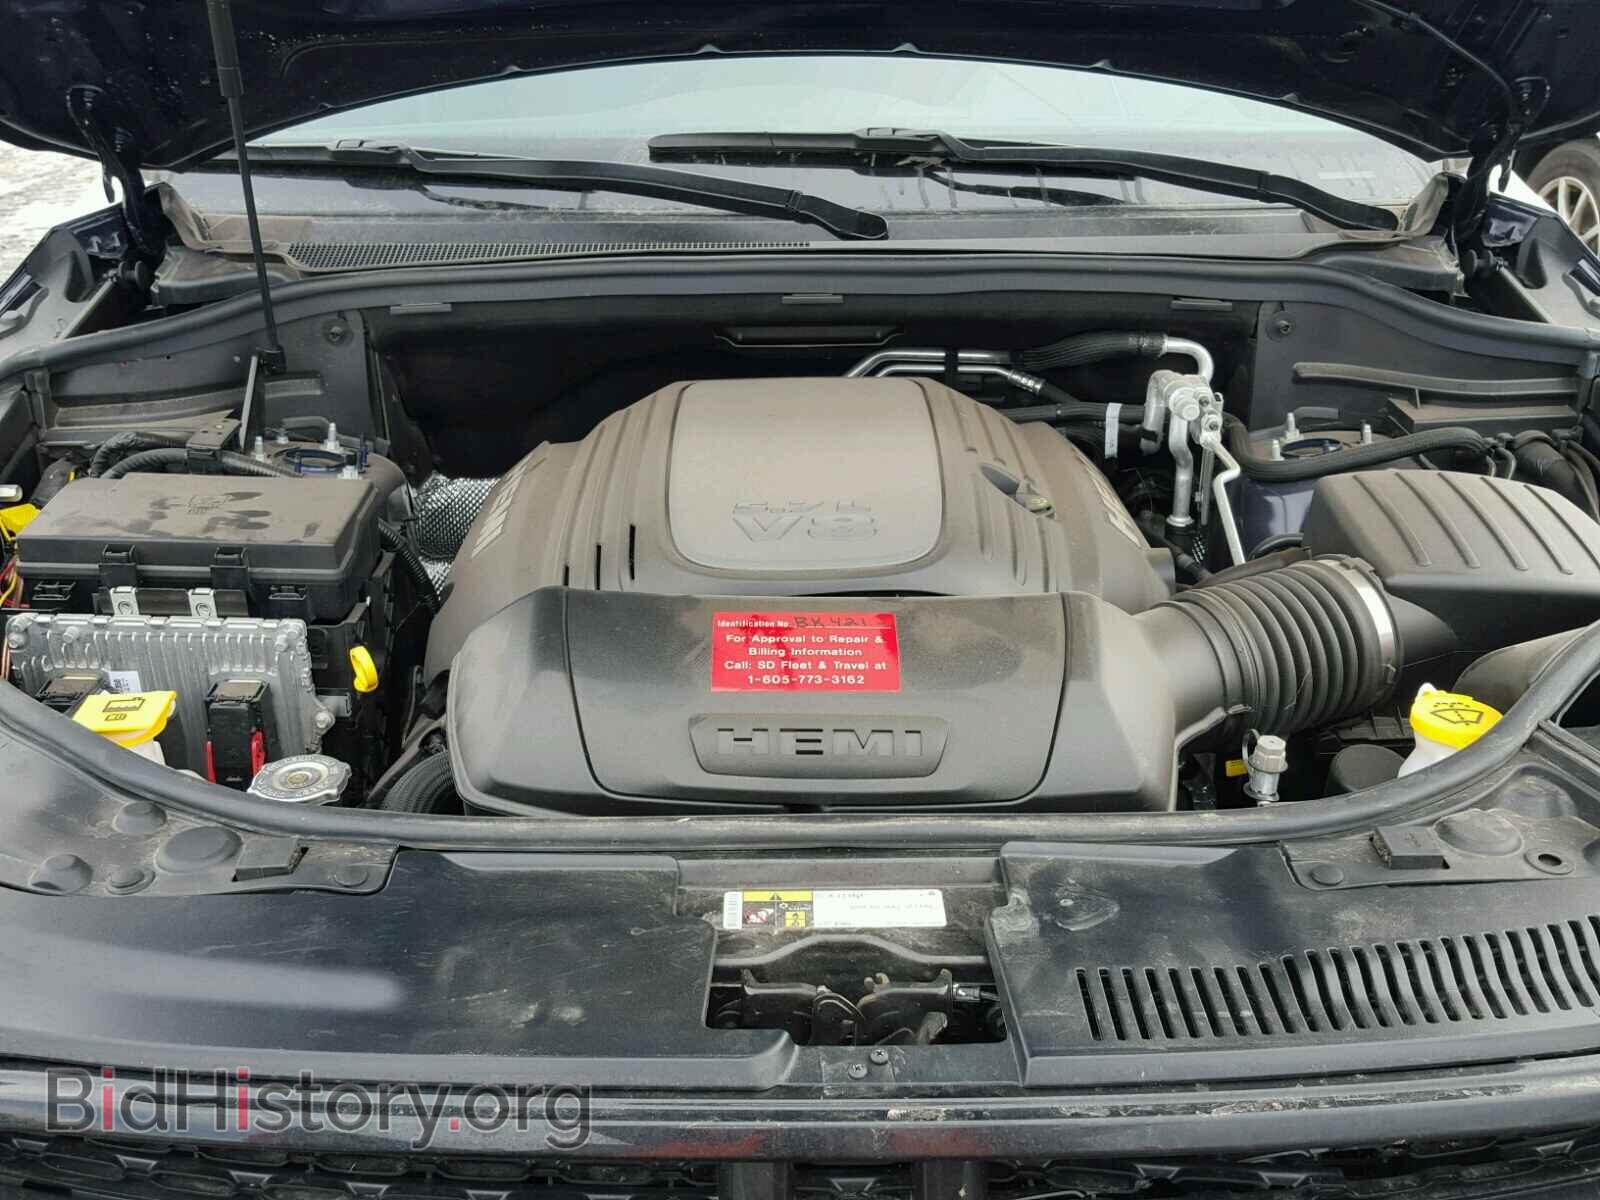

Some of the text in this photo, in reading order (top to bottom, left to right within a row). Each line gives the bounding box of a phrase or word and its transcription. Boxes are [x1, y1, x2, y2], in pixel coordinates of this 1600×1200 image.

[726, 635, 884, 645] For Approval to Repair &
[749, 648, 863, 658] Billing Information
[724, 661, 886, 670] Call: SD Fleet & Travel at
[748, 675, 865, 684] 1-605-773-3162
[716, 728, 923, 755] HEMI
